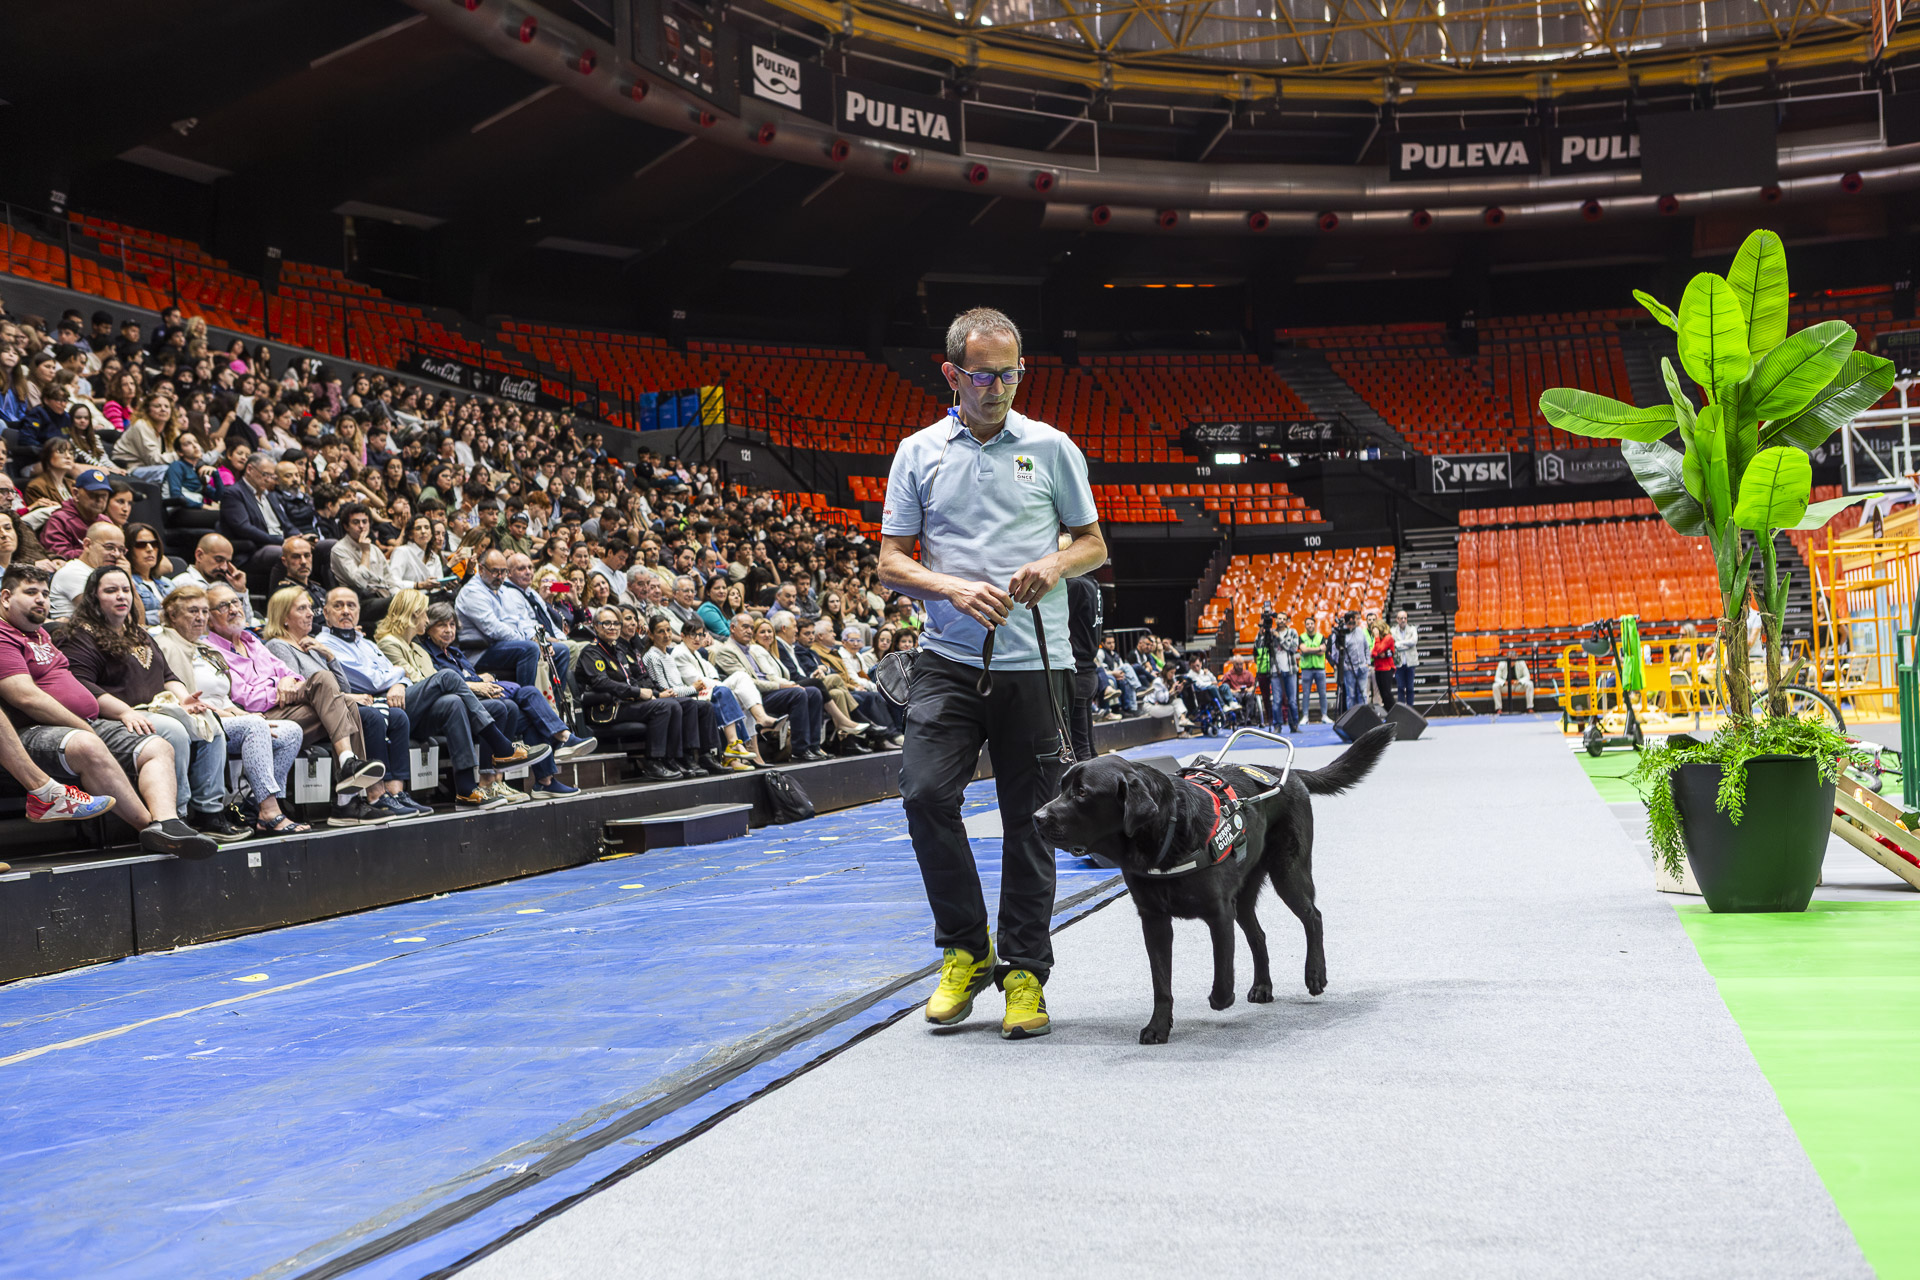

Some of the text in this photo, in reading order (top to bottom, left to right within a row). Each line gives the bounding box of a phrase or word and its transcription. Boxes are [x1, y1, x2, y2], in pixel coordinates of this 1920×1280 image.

[756, 53, 797, 80] PULEVA
[846, 90, 951, 141] PULEVA
[1401, 141, 1529, 170] PULEVA
[1561, 134, 1641, 164] PULE
[1196, 466, 1211, 476] 119
[1450, 462, 1507, 482] JYSK
[1304, 536, 1321, 546] 100
[1214, 823, 1232, 844] PERRO
